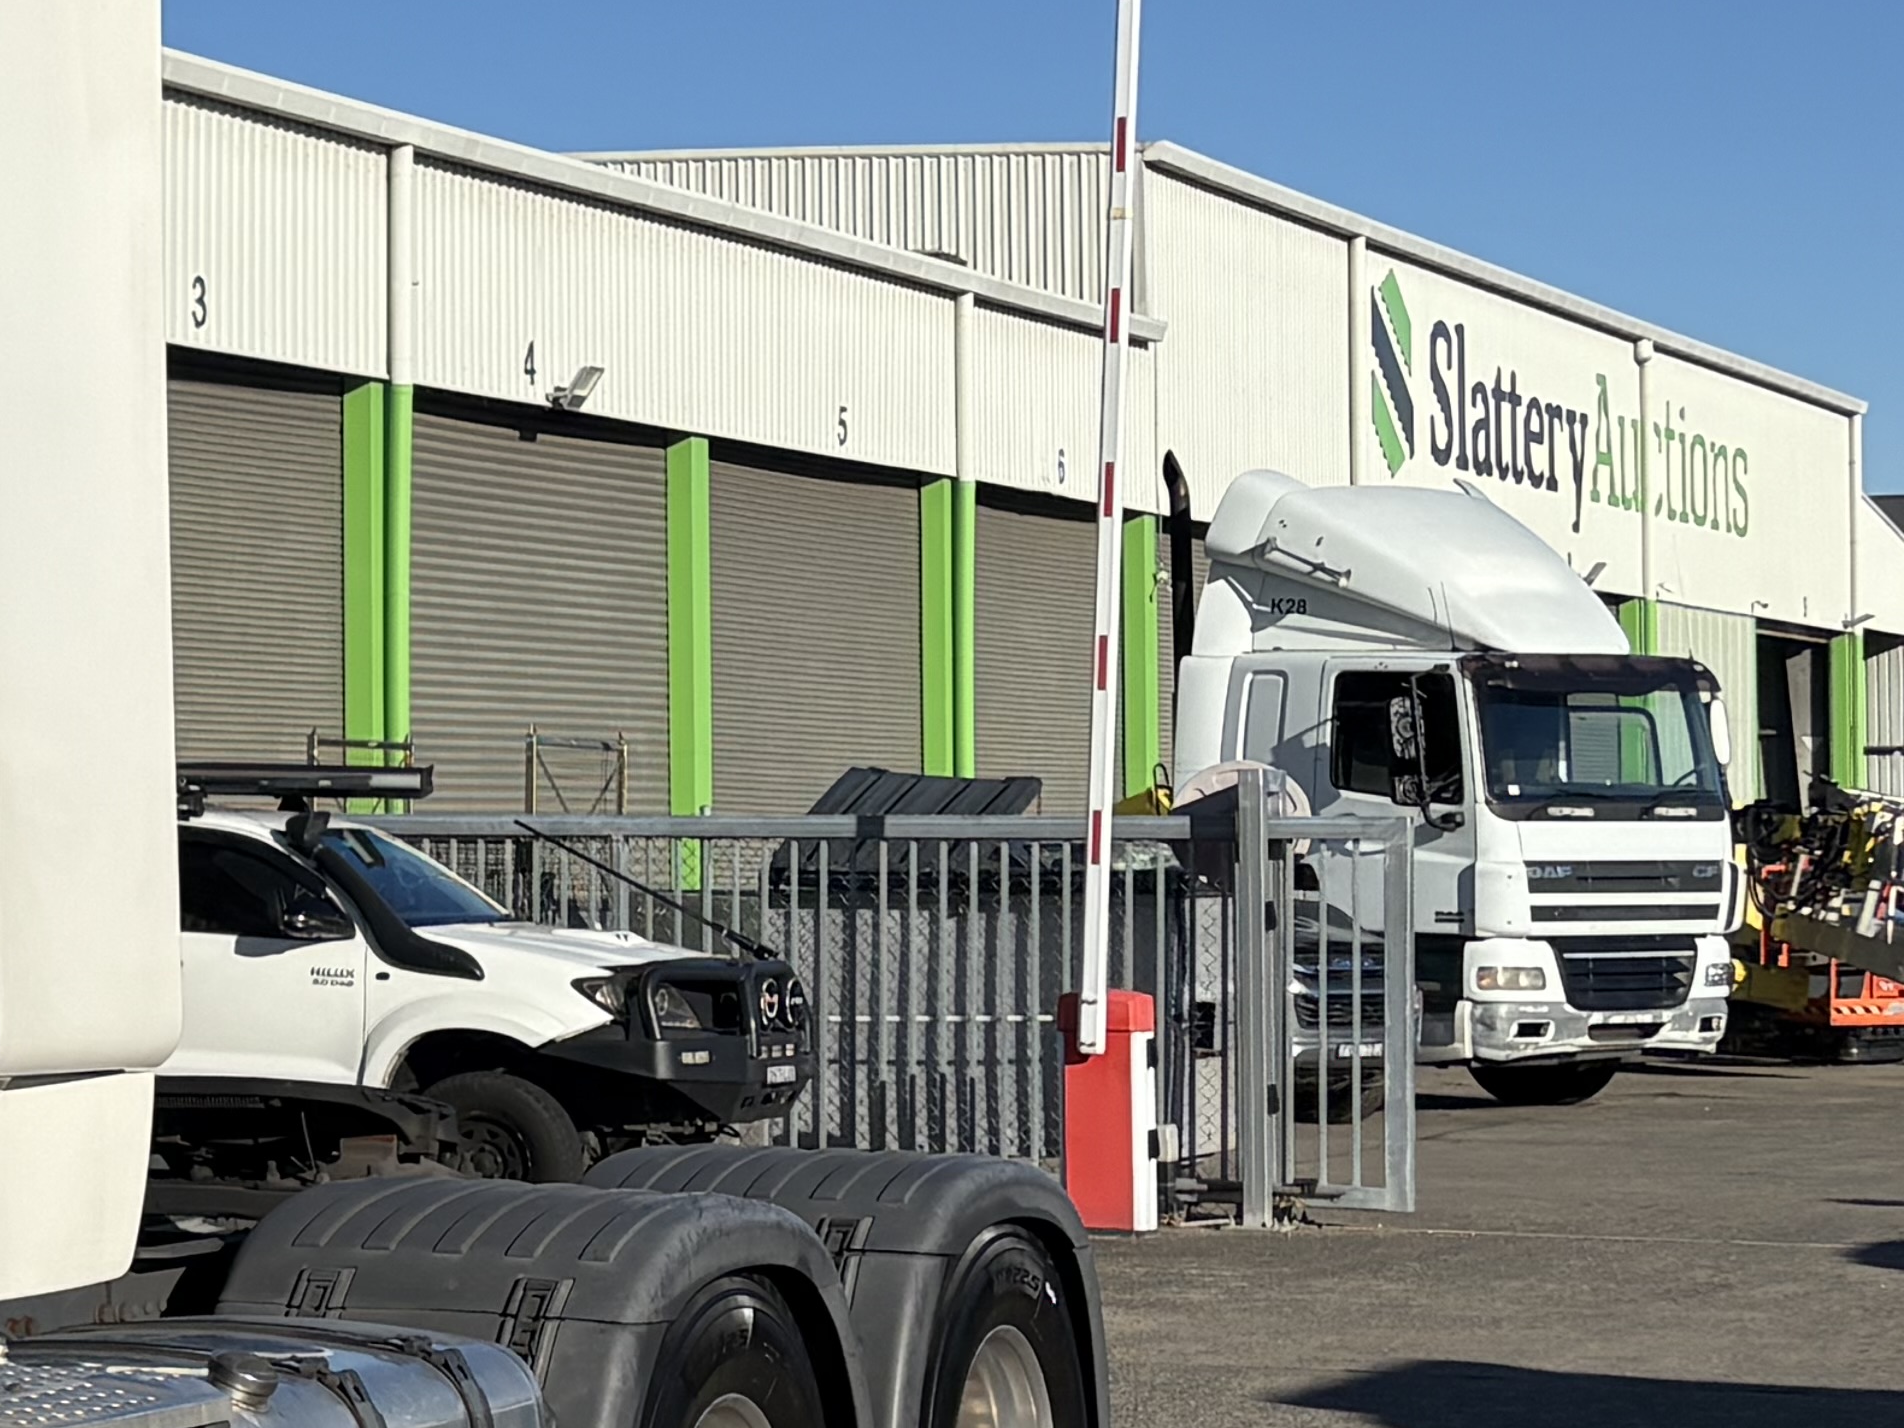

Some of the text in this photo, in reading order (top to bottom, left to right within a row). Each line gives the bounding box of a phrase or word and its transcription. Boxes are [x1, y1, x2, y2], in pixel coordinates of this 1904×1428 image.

[191, 275, 207, 328] 3
[523, 341, 536, 386] 4
[837, 406, 847, 447] 5
[1057, 448, 1065, 485] 6
[1271, 598, 1307, 615] K28
